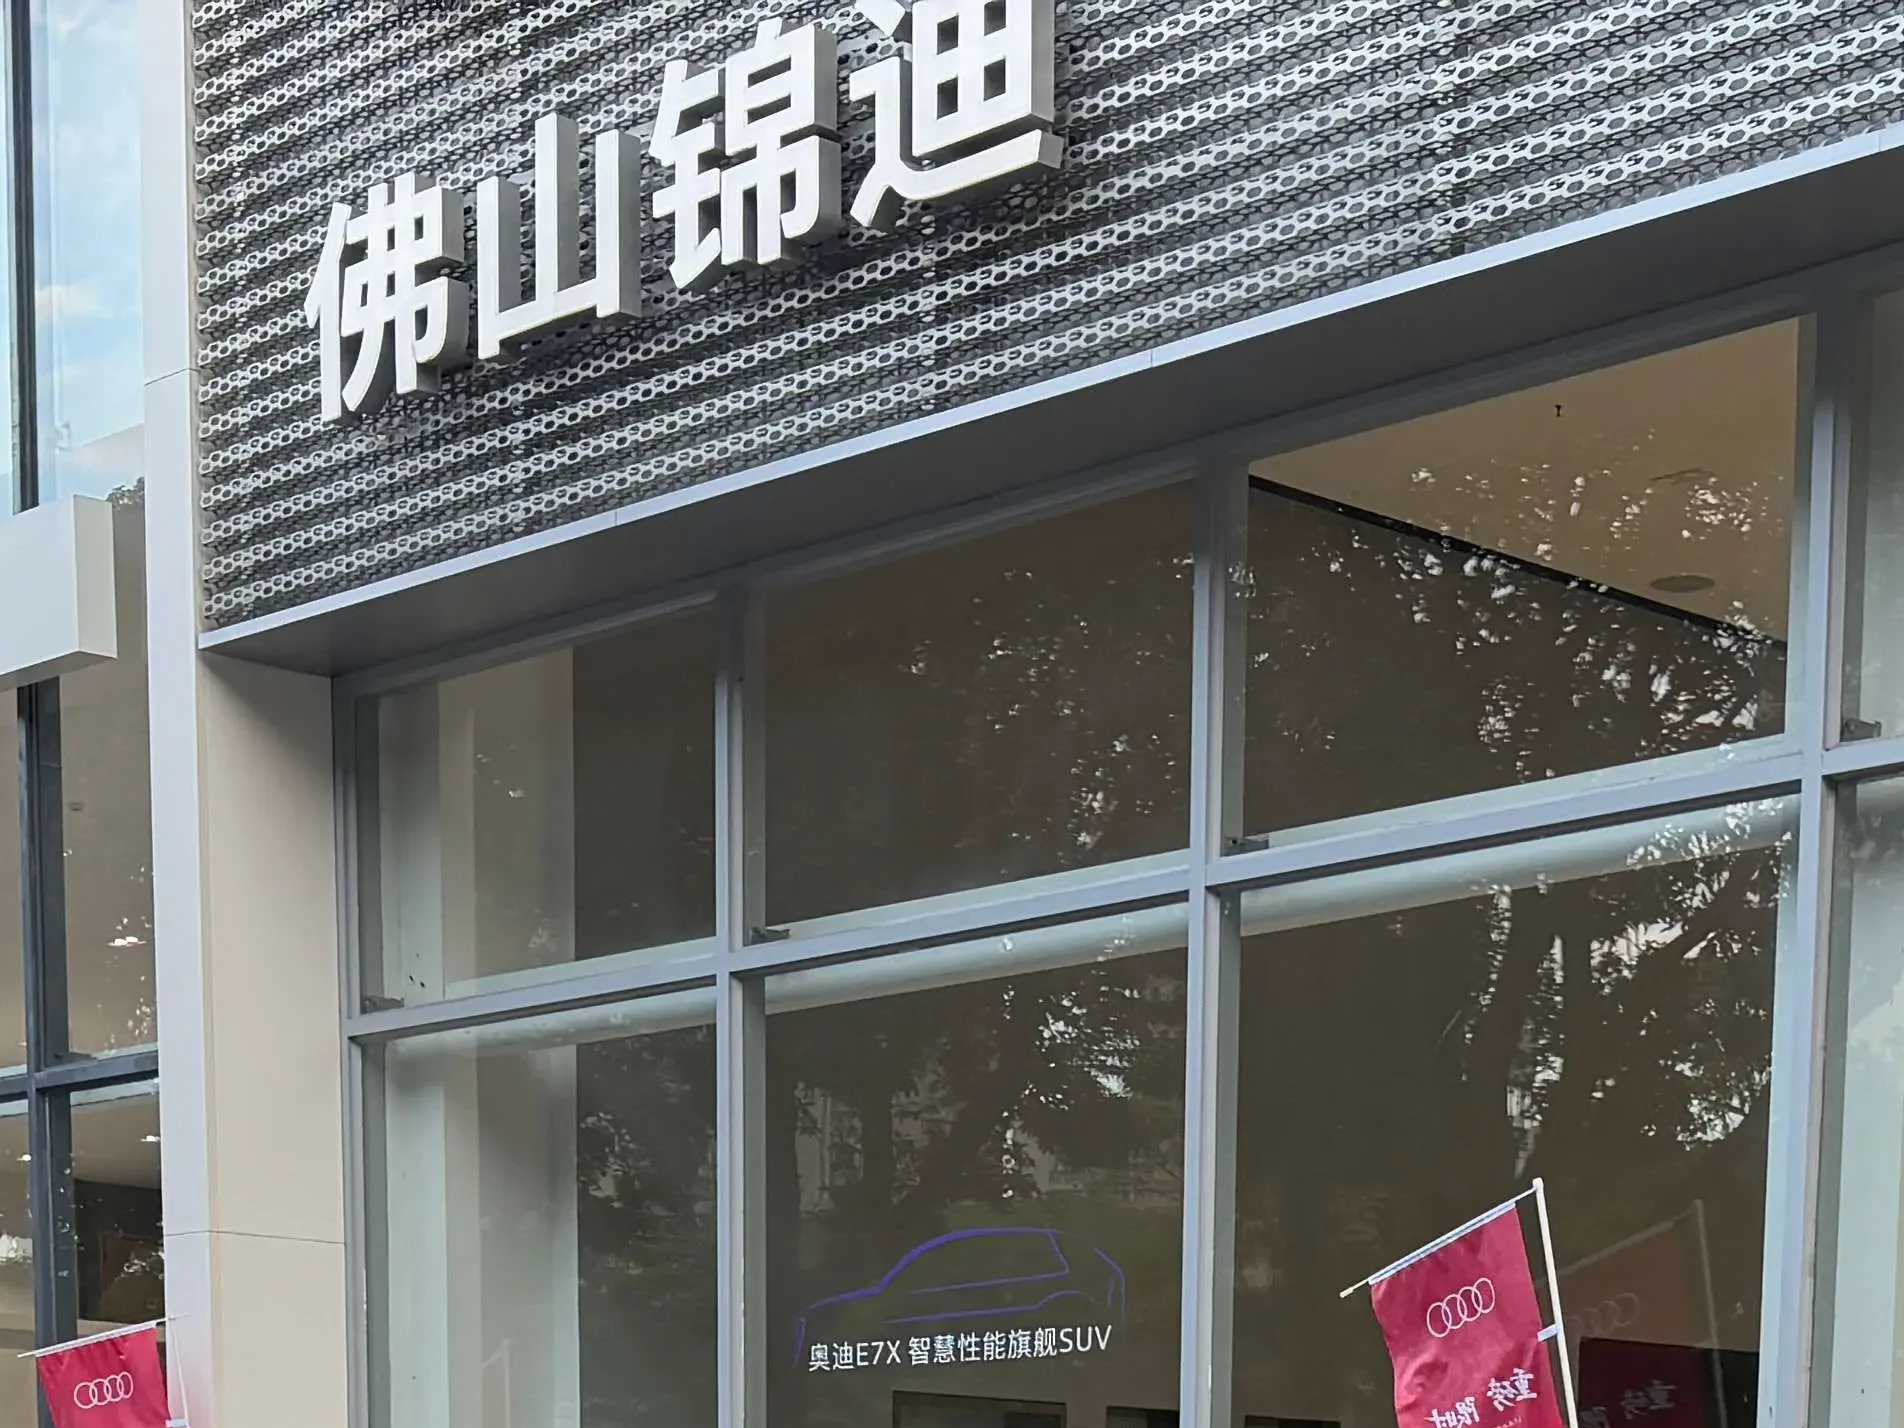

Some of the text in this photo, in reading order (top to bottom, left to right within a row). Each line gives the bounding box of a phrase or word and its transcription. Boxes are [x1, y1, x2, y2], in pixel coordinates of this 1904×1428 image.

[303, 0, 1064, 422] 佛山锦迪
[808, 1324, 1113, 1373] 奥迪E7X 智慧性能旗舰SUV
